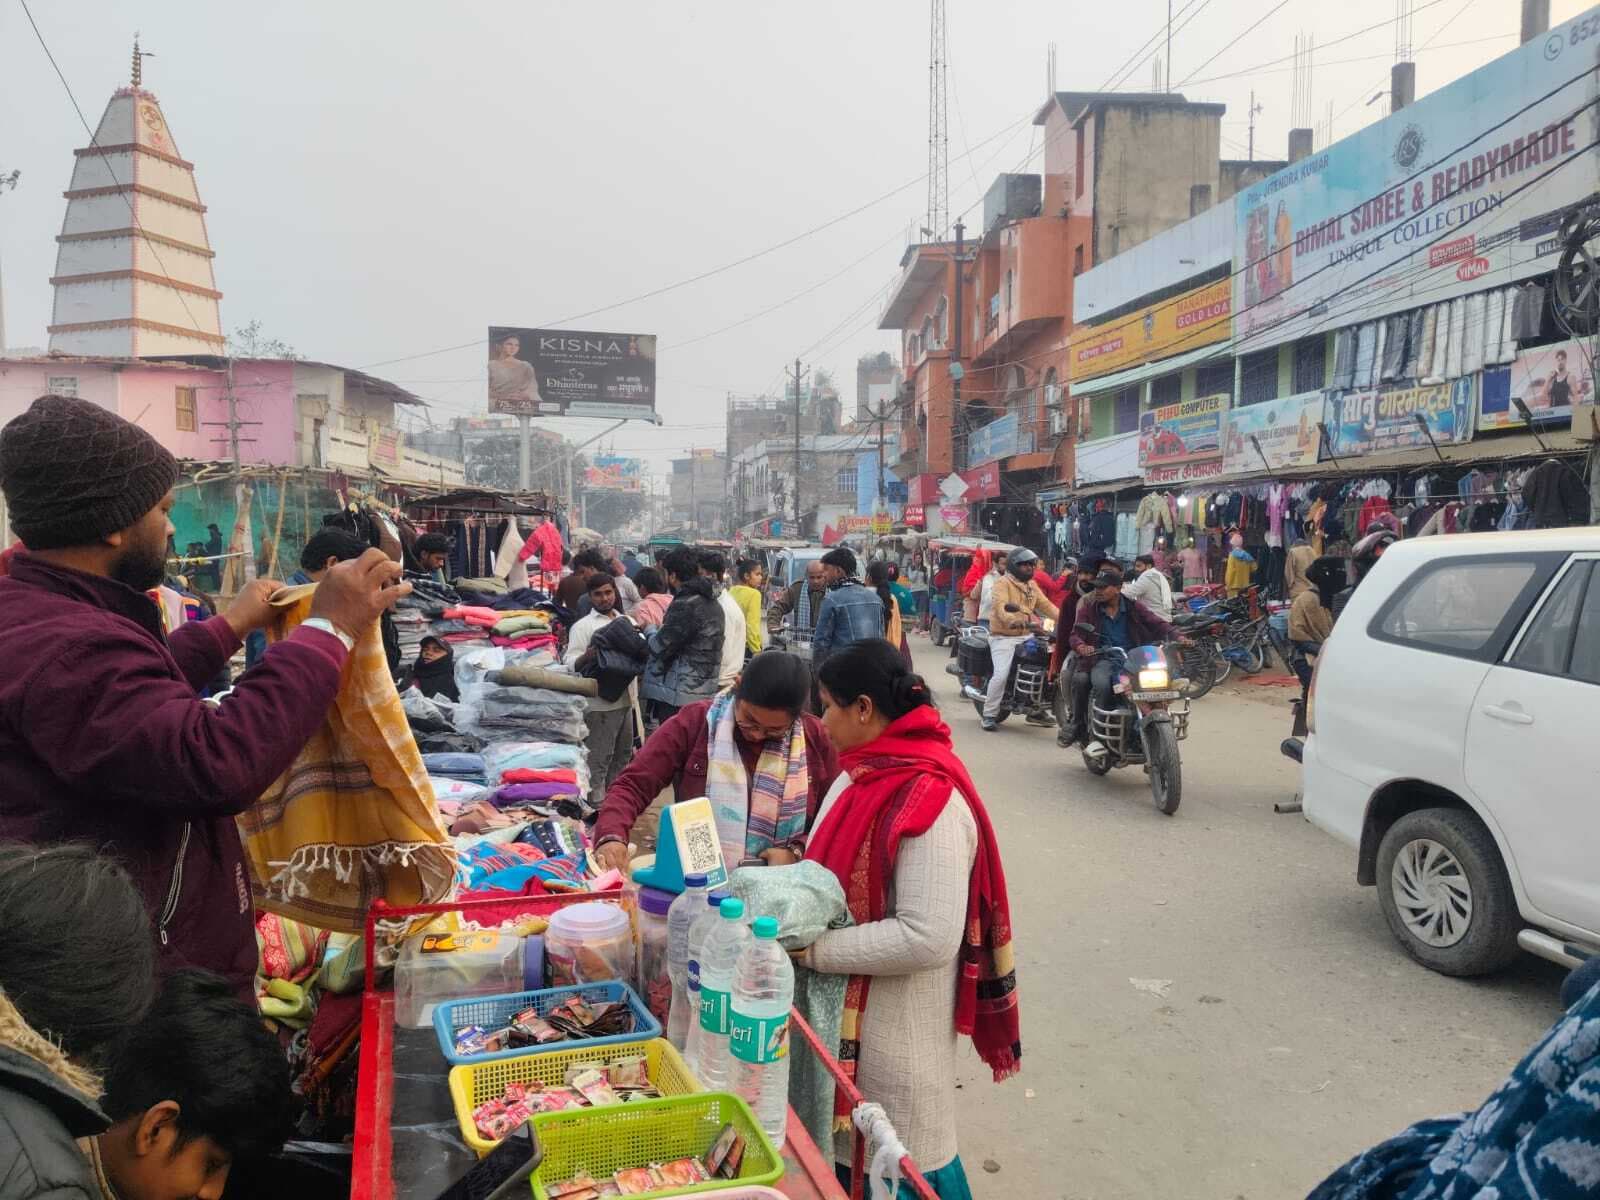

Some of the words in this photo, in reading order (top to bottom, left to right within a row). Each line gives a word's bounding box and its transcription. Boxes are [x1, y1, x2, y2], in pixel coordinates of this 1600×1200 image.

[1301, 155, 1330, 180] KUMAR
[1295, 215, 1346, 257] BIMAL
[1350, 187, 1406, 236] SAREE
[1411, 181, 1425, 212] &
[1431, 120, 1575, 206] READYMADE
[1329, 239, 1385, 265] UNIQUE
[1393, 190, 1503, 245] COLLECTION
[1459, 261, 1487, 278] VIMAL
[1176, 286, 1230, 312] MANAPPURA
[1177, 310, 1205, 327] GOLD
[1207, 301, 1230, 320] LOA
[540, 338, 622, 353] KISNA
[1157, 405, 1180, 421] PIHU
[1180, 397, 1220, 415] COMPUTER
[905, 506, 923, 515] ATM
